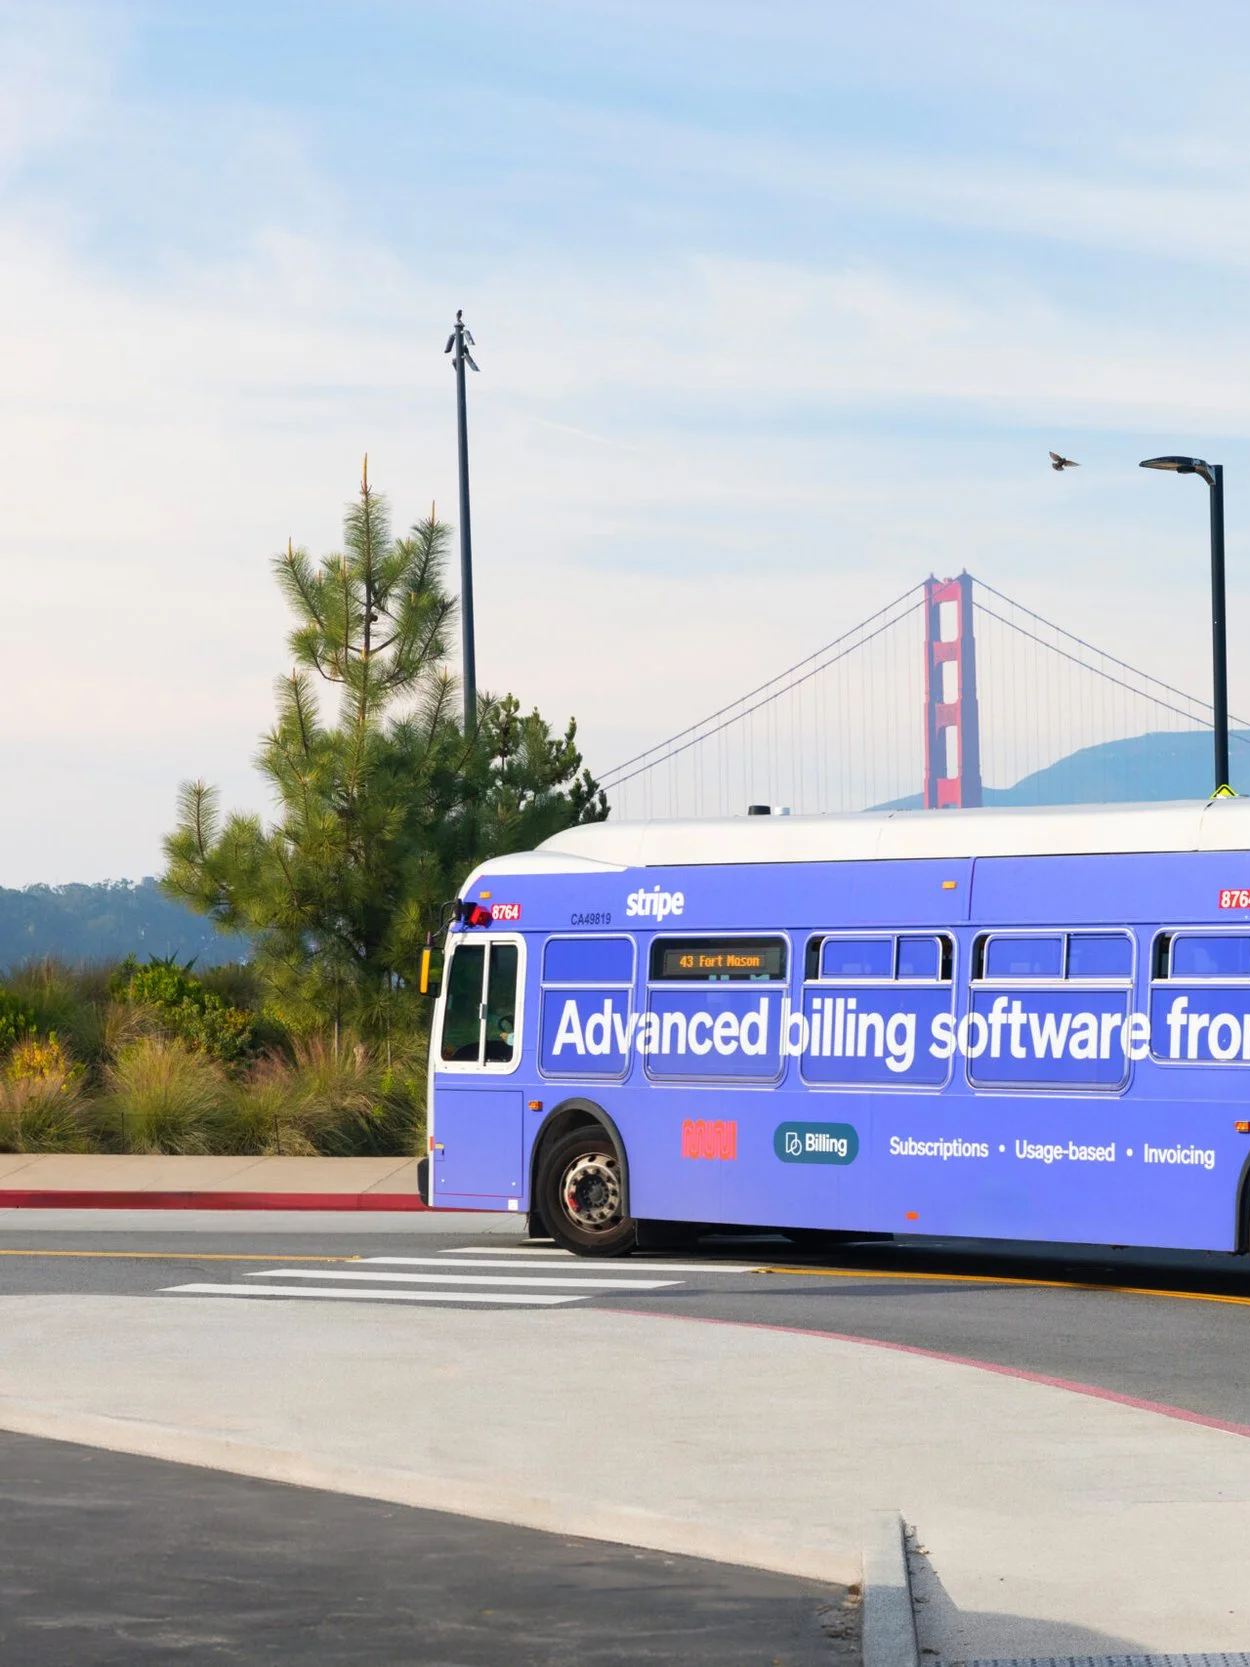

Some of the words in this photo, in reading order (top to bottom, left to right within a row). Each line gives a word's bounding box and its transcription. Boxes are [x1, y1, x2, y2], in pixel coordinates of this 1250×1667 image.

[492, 904, 519, 920] 8764
[626, 885, 685, 922] stripe
[570, 912, 612, 926] CA49819
[680, 955, 694, 968] 43
[699, 955, 722, 967] Fort
[726, 955, 760, 967] Mason
[552, 997, 769, 1056] Advanced
[779, 997, 917, 1073] billing
[929, 996, 1151, 1059] software
[805, 1133, 848, 1157] Billing
[890, 1136, 988, 1160] Subscriptions
[1015, 1139, 1115, 1164] Usage-based
[1144, 1143, 1215, 1170] Invoicing
